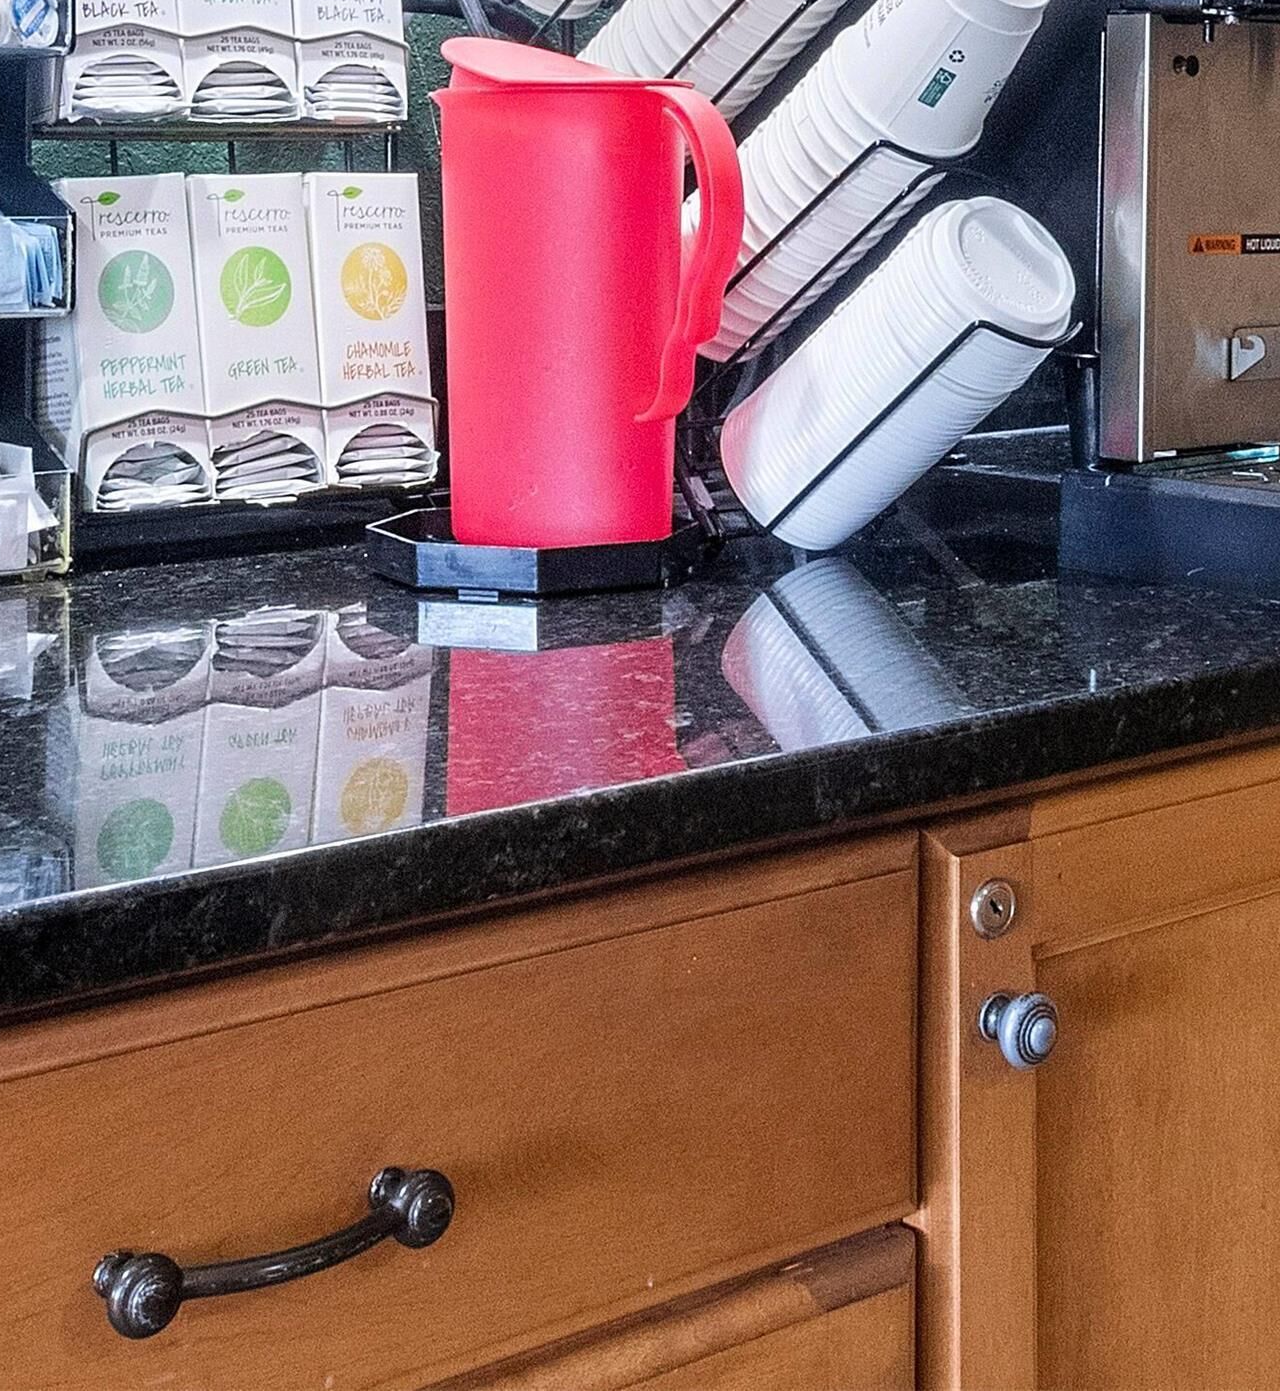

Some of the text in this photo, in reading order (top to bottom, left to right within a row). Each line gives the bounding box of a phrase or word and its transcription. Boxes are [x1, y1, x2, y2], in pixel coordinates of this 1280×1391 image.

[82, 1, 158, 18] BLACK TEA
[317, 6, 385, 23] BLACK TEA
[126, 29, 144, 37] BAGS
[230, 36, 243, 44] TEA
[225, 225, 289, 234] PREMIUM TEAS
[343, 221, 403, 230] PREMIUM TEAS
[99, 228, 168, 239] PREMIUM TEAS
[1246, 238, 1260, 250] HOT
[346, 341, 412, 360] CHAMOMILE
[100, 352, 186, 377] PEPPERMINT
[228, 356, 297, 380] GREEN TEA
[343, 361, 416, 381] HERBAL TEA
[103, 375, 185, 399] HERBAL TEA
[373, 399, 401, 408] TEA BAGS
[256, 408, 286, 417] TEA BAGS
[137, 417, 170, 427] TEA BAGS
[232, 421, 246, 429] NET
[111, 431, 126, 439] NET
